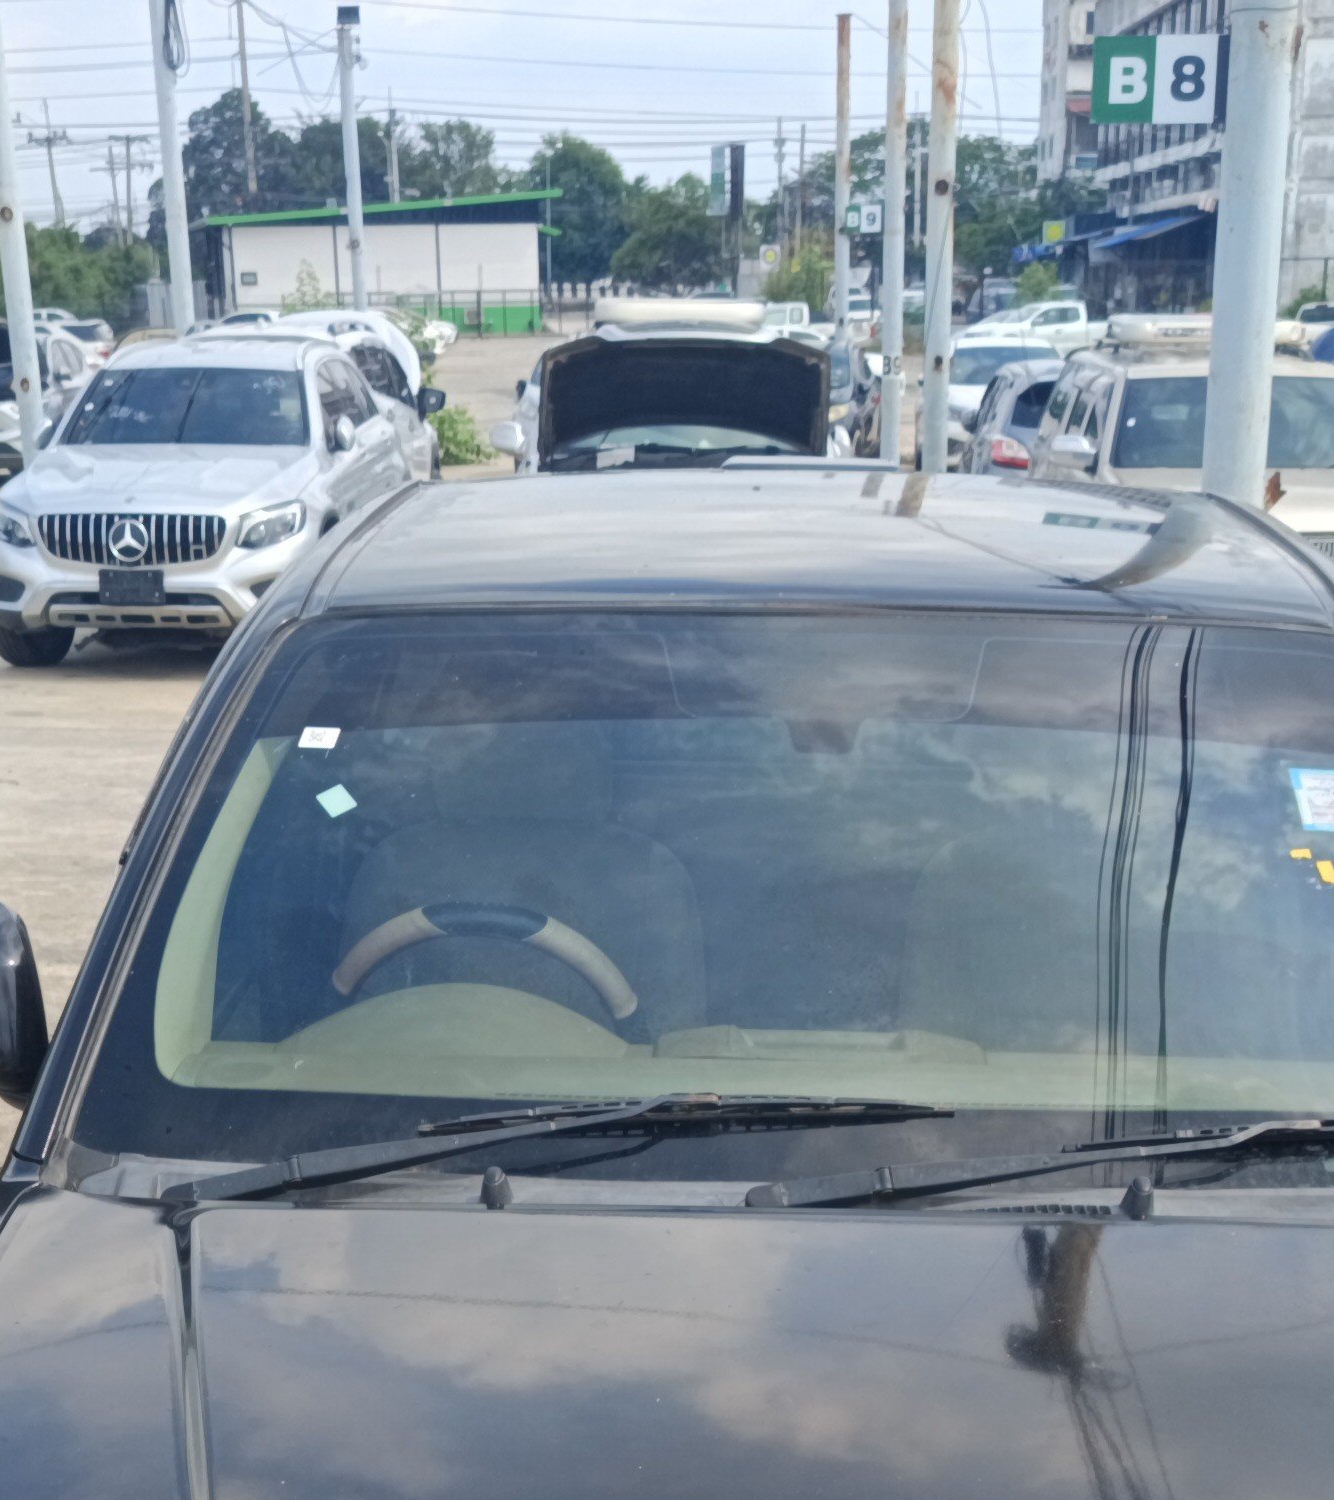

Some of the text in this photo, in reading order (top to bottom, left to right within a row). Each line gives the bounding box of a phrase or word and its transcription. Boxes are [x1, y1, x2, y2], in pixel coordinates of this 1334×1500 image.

[1108, 55, 1205, 105] B 8
[866, 212, 877, 227] 9
